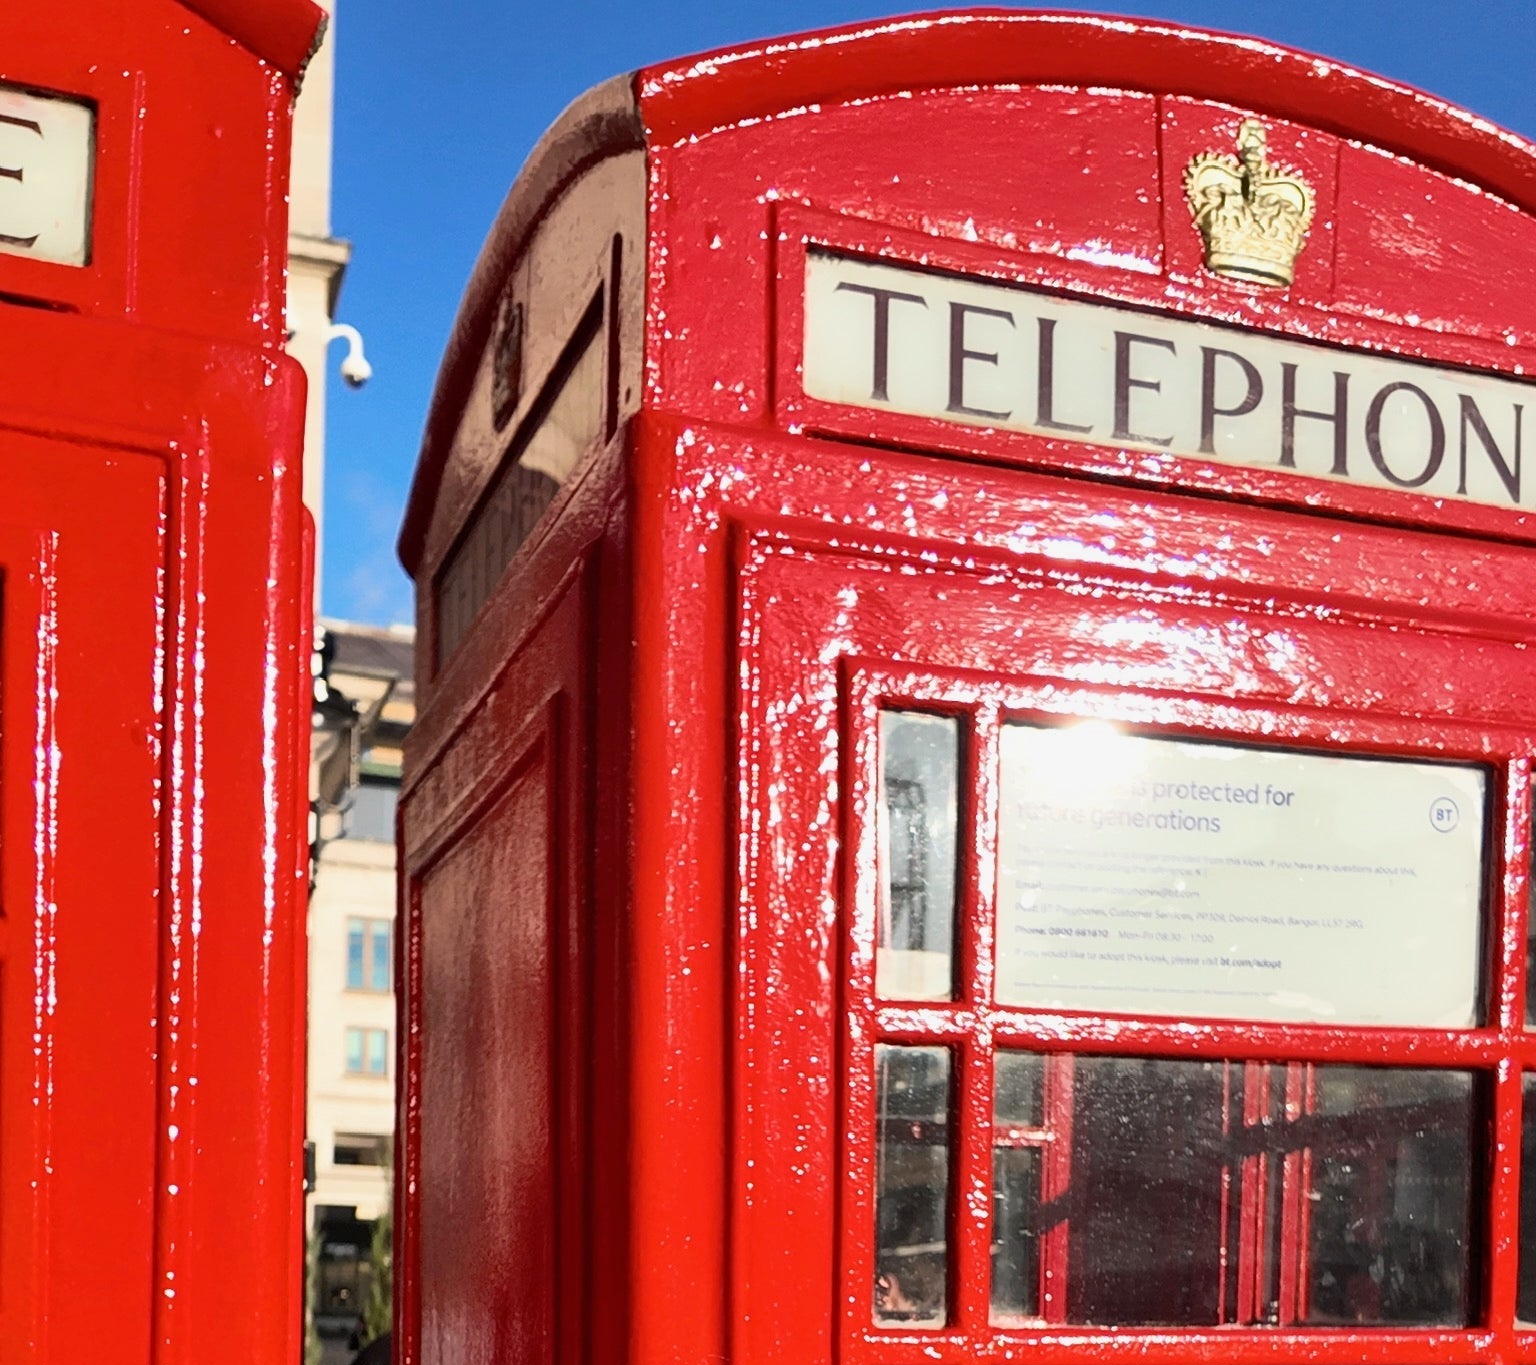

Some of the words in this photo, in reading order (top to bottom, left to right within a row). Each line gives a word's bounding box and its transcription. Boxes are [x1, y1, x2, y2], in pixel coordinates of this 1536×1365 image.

[834, 281, 1524, 503] TELEPHON
[1153, 780, 1259, 804] protected
[1265, 784, 1295, 807] for
[1090, 807, 1221, 834] generations
[1437, 808, 1453, 821] BT
